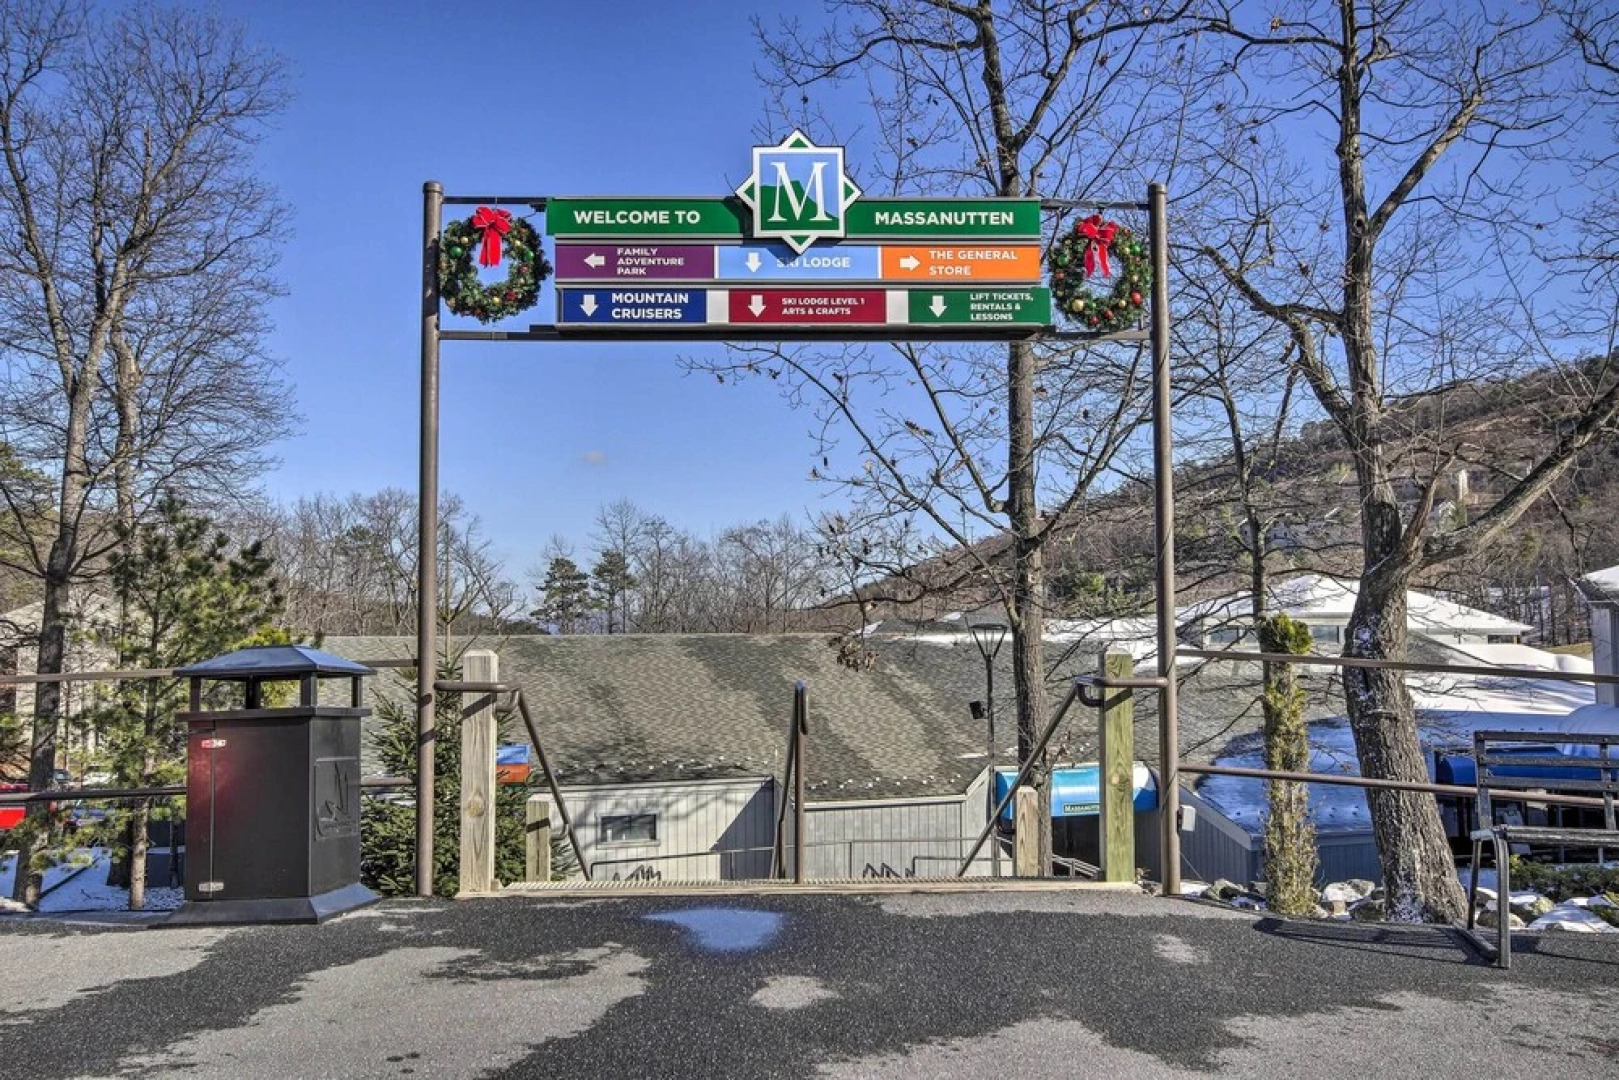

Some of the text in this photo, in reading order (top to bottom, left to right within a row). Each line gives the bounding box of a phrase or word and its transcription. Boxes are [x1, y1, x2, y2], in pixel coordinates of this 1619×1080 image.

[767, 161, 833, 222] M
[573, 210, 701, 225] WELCOME TO
[875, 211, 1014, 226] MASSANUTTEN
[617, 248, 658, 256] FAMILY
[929, 250, 1018, 260] THE GENERAL
[617, 257, 684, 266] ADVENTURE
[803, 257, 851, 268] LODGE
[617, 266, 647, 275] PARK
[929, 266, 971, 276] STORE
[612, 292, 689, 304] MOUNTAIN
[992, 293, 1034, 301] TICKETS,
[612, 308, 683, 319] CRUISERS
[970, 313, 1013, 321] LESSONS
